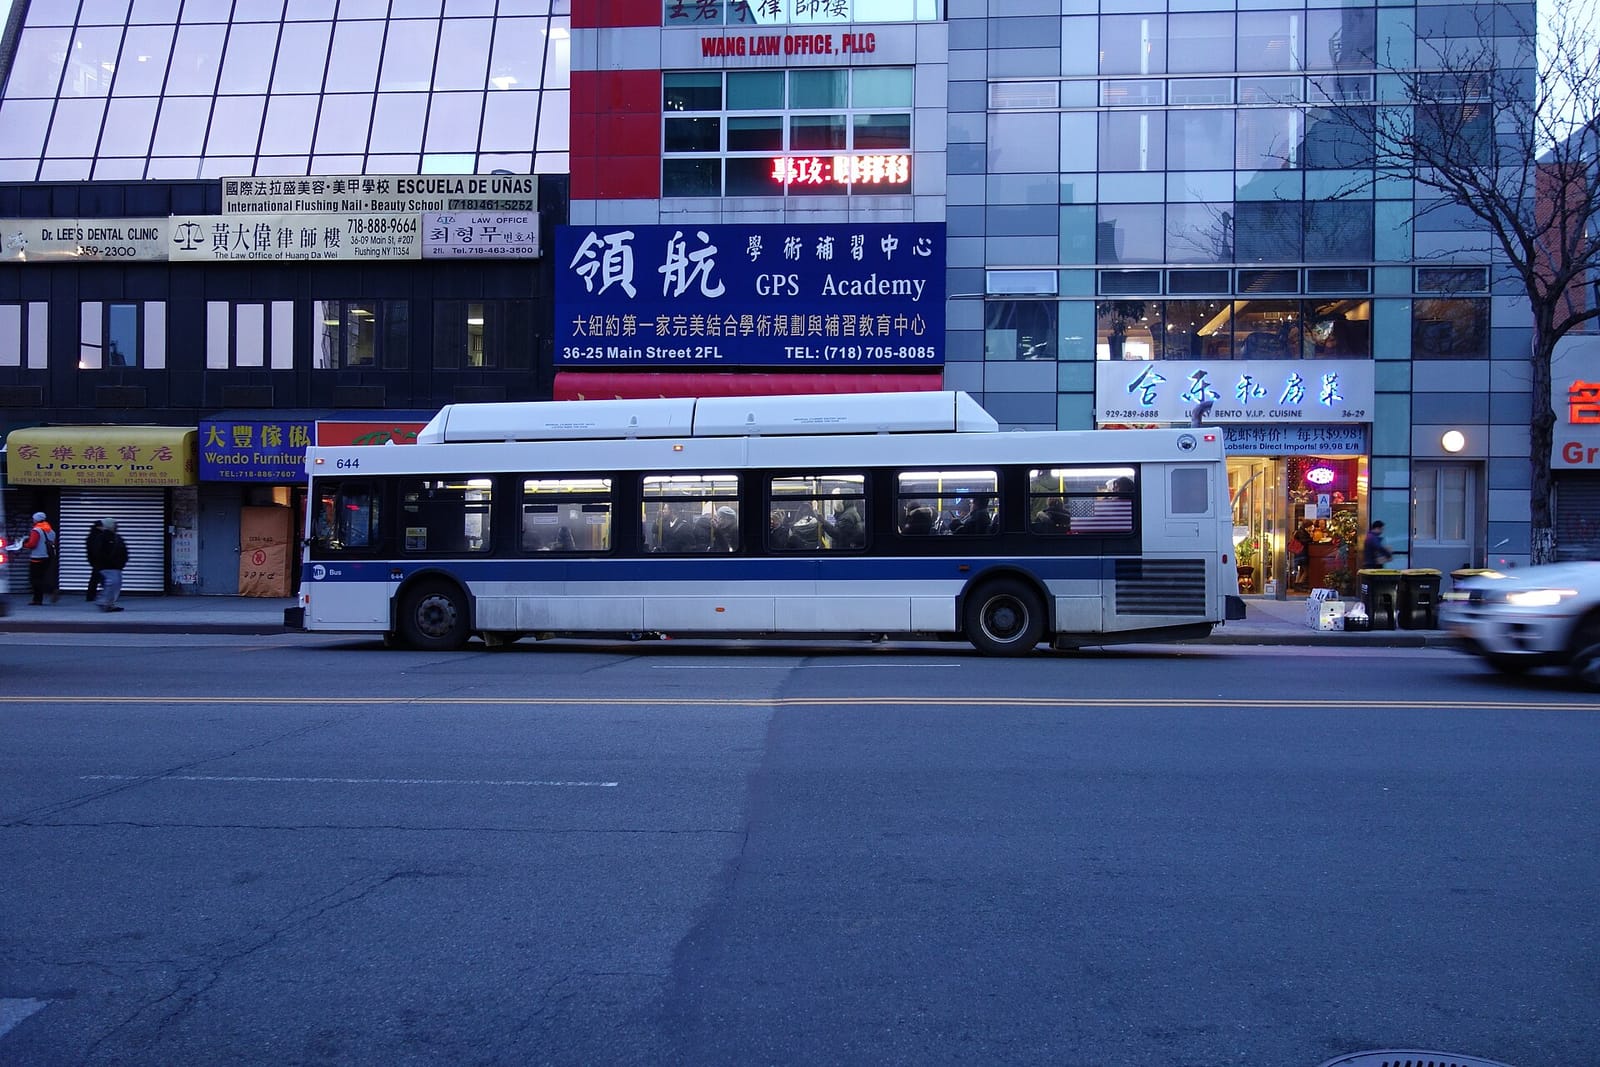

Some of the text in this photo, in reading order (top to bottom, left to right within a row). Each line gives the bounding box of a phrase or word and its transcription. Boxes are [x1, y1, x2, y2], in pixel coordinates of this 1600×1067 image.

[701, 36, 745, 57] WANG
[749, 36, 782, 56] LAW
[842, 32, 875, 53] PLLC
[397, 176, 532, 194] ESCUELA DE UÑAS
[228, 199, 443, 213] International Flushing Nail Beauty School
[448, 199, 533, 211] (718)461-5252
[348, 218, 417, 233] 718-888-9664
[42, 228, 159, 241] Dr. LEE'S DENTAL CLINIC
[212, 223, 341, 251] 黃大偉律師樓
[351, 236, 369, 245] 36-09
[370, 236, 390, 245] Main
[398, 236, 414, 245] #207
[430, 226, 536, 243] 최형무 변호사
[354, 247, 409, 258] Flushing NY 11354
[746, 234, 932, 262] 學術補習中心
[285, 252, 312, 260] Huang
[324, 251, 338, 259] Wei
[569, 230, 726, 299] 領航
[756, 273, 926, 302] GPS Academy
[572, 314, 926, 337] 大紐約第一家完美結合學術規劃與補習教育中心
[563, 347, 723, 359] 36-25 Main Street 2FL
[784, 346, 935, 360] TEL: (718) 705-8085
[1105, 410, 1159, 418] 929-289-6888
[1215, 410, 1242, 418] BENTO
[1246, 410, 1265, 418] V.I.P.
[1269, 409, 1303, 417] CUISINE
[1342, 410, 1365, 418] 36-29
[203, 425, 311, 448] 大豐傢俬
[1259, 442, 1282, 450] Direct
[204, 452, 249, 465] Wendo
[336, 459, 360, 469] 644
[1320, 495, 1328, 504] A
